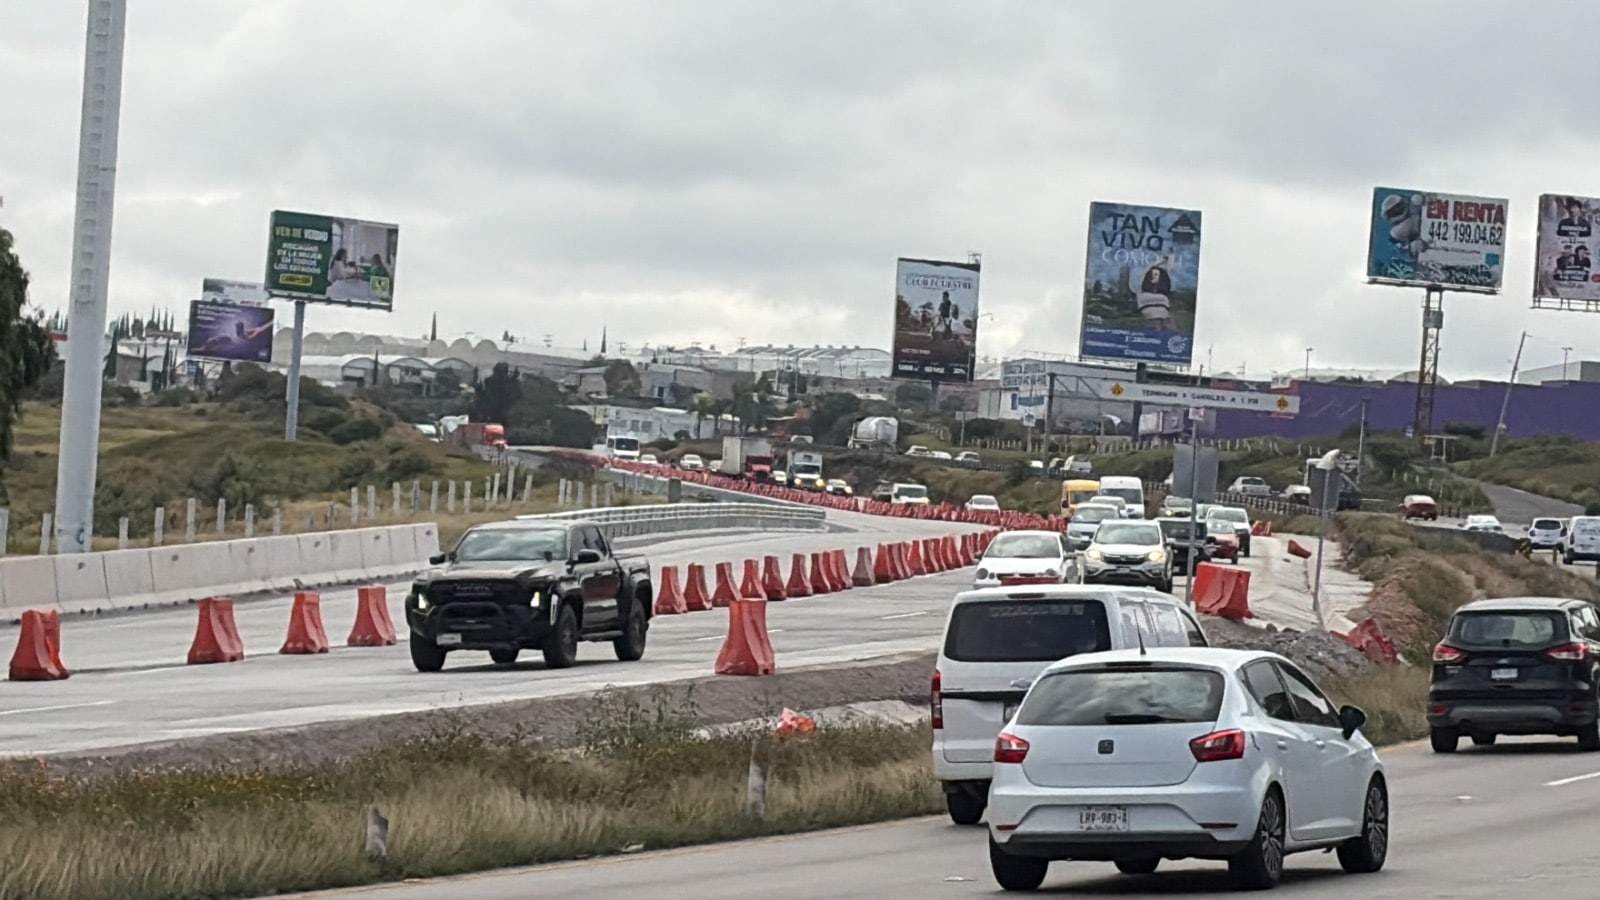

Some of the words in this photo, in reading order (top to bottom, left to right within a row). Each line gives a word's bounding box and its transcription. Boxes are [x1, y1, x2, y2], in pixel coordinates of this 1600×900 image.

[1426, 199, 1449, 220] EN
[1452, 200, 1505, 224] RENTA
[1106, 213, 1160, 234] TAN
[1428, 222, 1449, 241] 442
[1453, 223, 1503, 246] 199.04.62
[1101, 231, 1163, 251] VIVO
[1102, 247, 1160, 265] COMO
